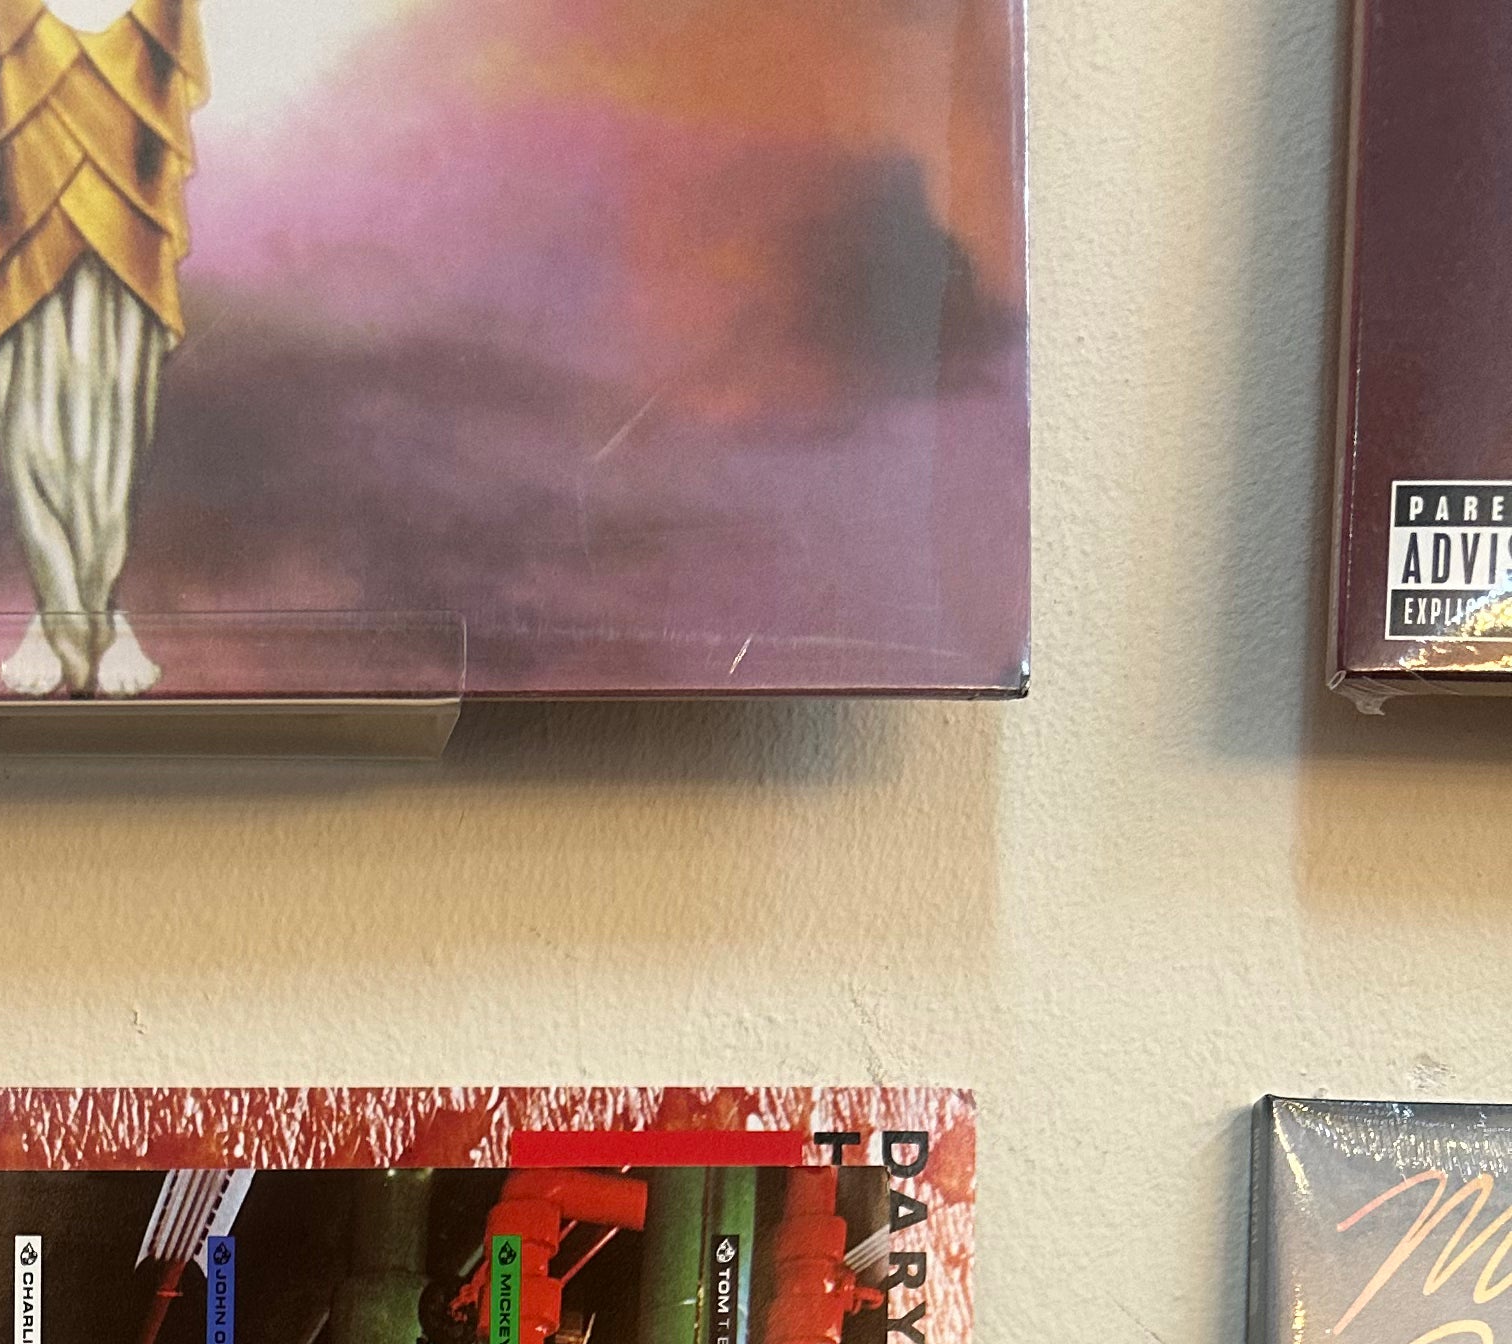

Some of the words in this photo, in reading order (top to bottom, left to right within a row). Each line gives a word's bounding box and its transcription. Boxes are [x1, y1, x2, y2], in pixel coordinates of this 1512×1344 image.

[1401, 532, 1512, 585] ADVI
[214, 1269, 227, 1326] JOHN
[717, 1268, 731, 1314] TOM
